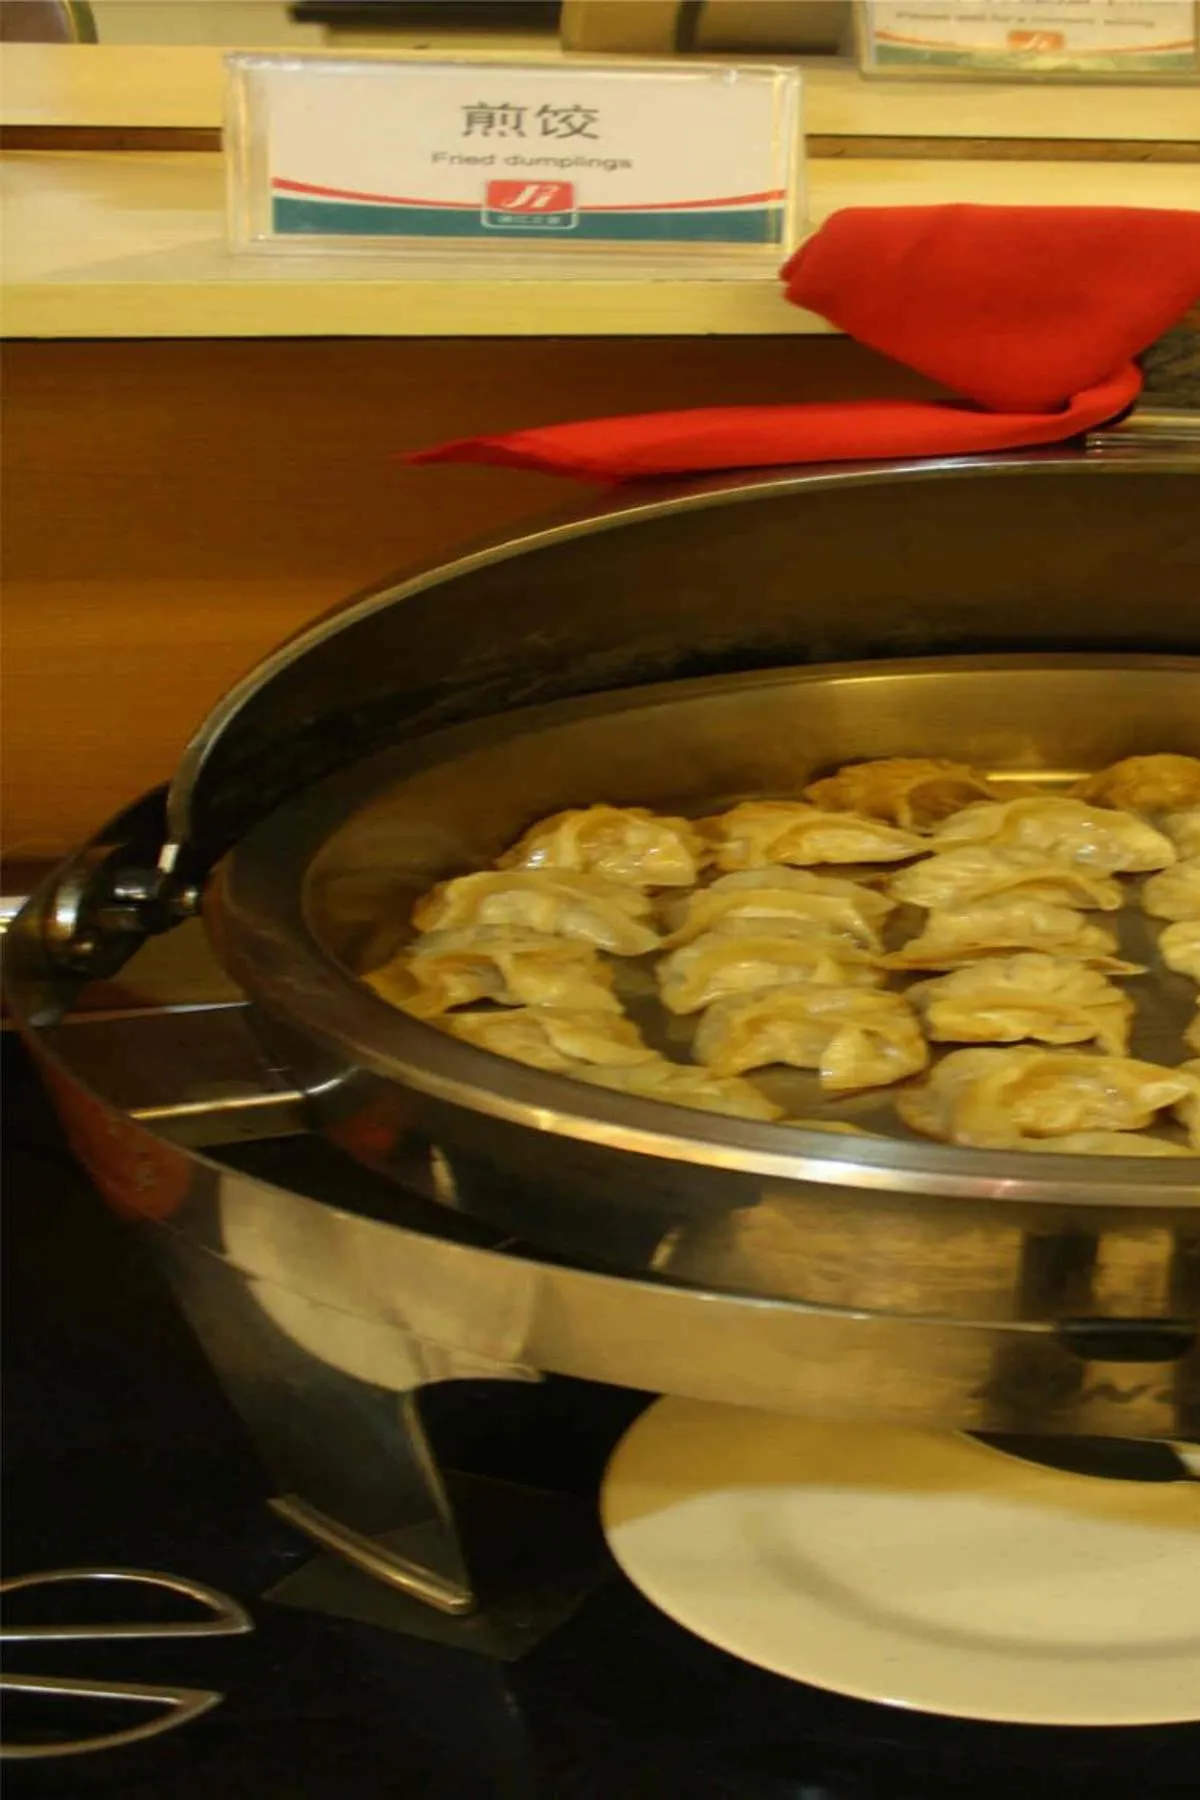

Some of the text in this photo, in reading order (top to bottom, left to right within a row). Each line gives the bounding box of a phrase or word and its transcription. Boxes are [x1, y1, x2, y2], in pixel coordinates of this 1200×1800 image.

[461, 101, 600, 139] 煎饺
[431, 152, 634, 171] Fried dumplings
